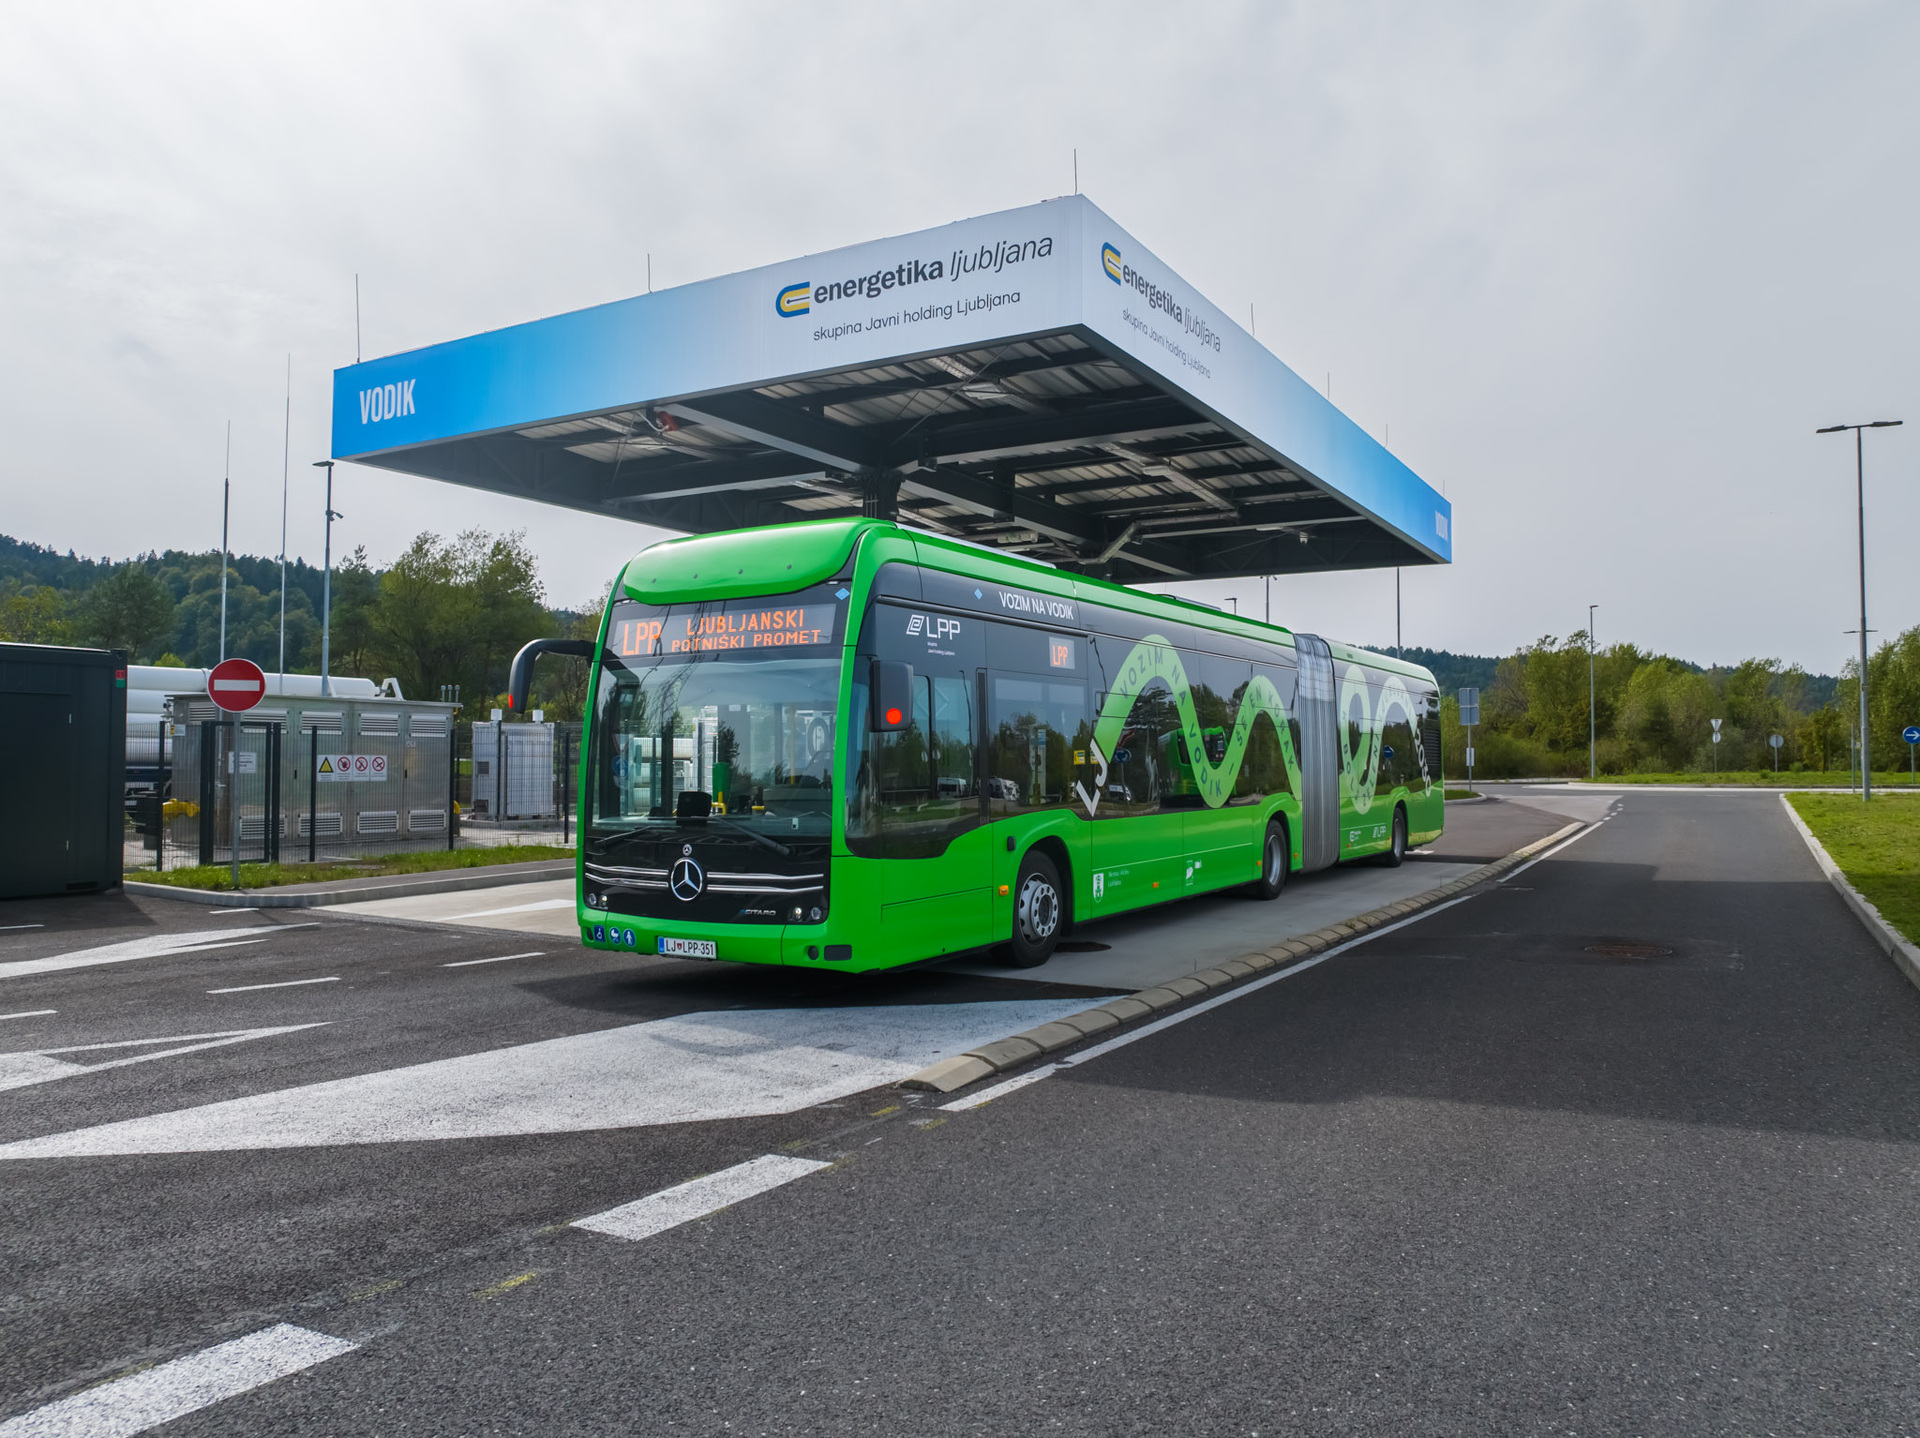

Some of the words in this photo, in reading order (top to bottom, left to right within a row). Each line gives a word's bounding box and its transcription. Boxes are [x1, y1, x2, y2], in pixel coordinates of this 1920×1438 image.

[813, 259, 943, 304] energetika
[950, 237, 1053, 282] ljubljana
[813, 322, 862, 341] skupina
[865, 312, 900, 331] Javni
[904, 304, 953, 324] holding
[957, 291, 1021, 316] Ljubljana
[1122, 264, 1183, 324] energetika
[1184, 307, 1221, 352] ljubljana
[1122, 307, 1148, 335] skupina
[1149, 326, 1165, 348] Javni
[1166, 337, 1187, 365] holding
[359, 378, 416, 425] VODIK
[686, 609, 804, 636] LJUBLJANSKI
[998, 591, 1031, 612] VOZIM
[1031, 598, 1046, 615] NA
[1045, 601, 1074, 620] VODIK
[622, 621, 662, 656] LPP
[671, 633, 745, 653] POTNIŠKI
[753, 629, 822, 648] PROMET
[926, 616, 961, 640] LPP
[1052, 644, 1069, 666] LPP
[1119, 646, 1164, 700] VOZIM
[665, 940, 677, 952] LJ
[682, 941, 714, 956] LPP-351
